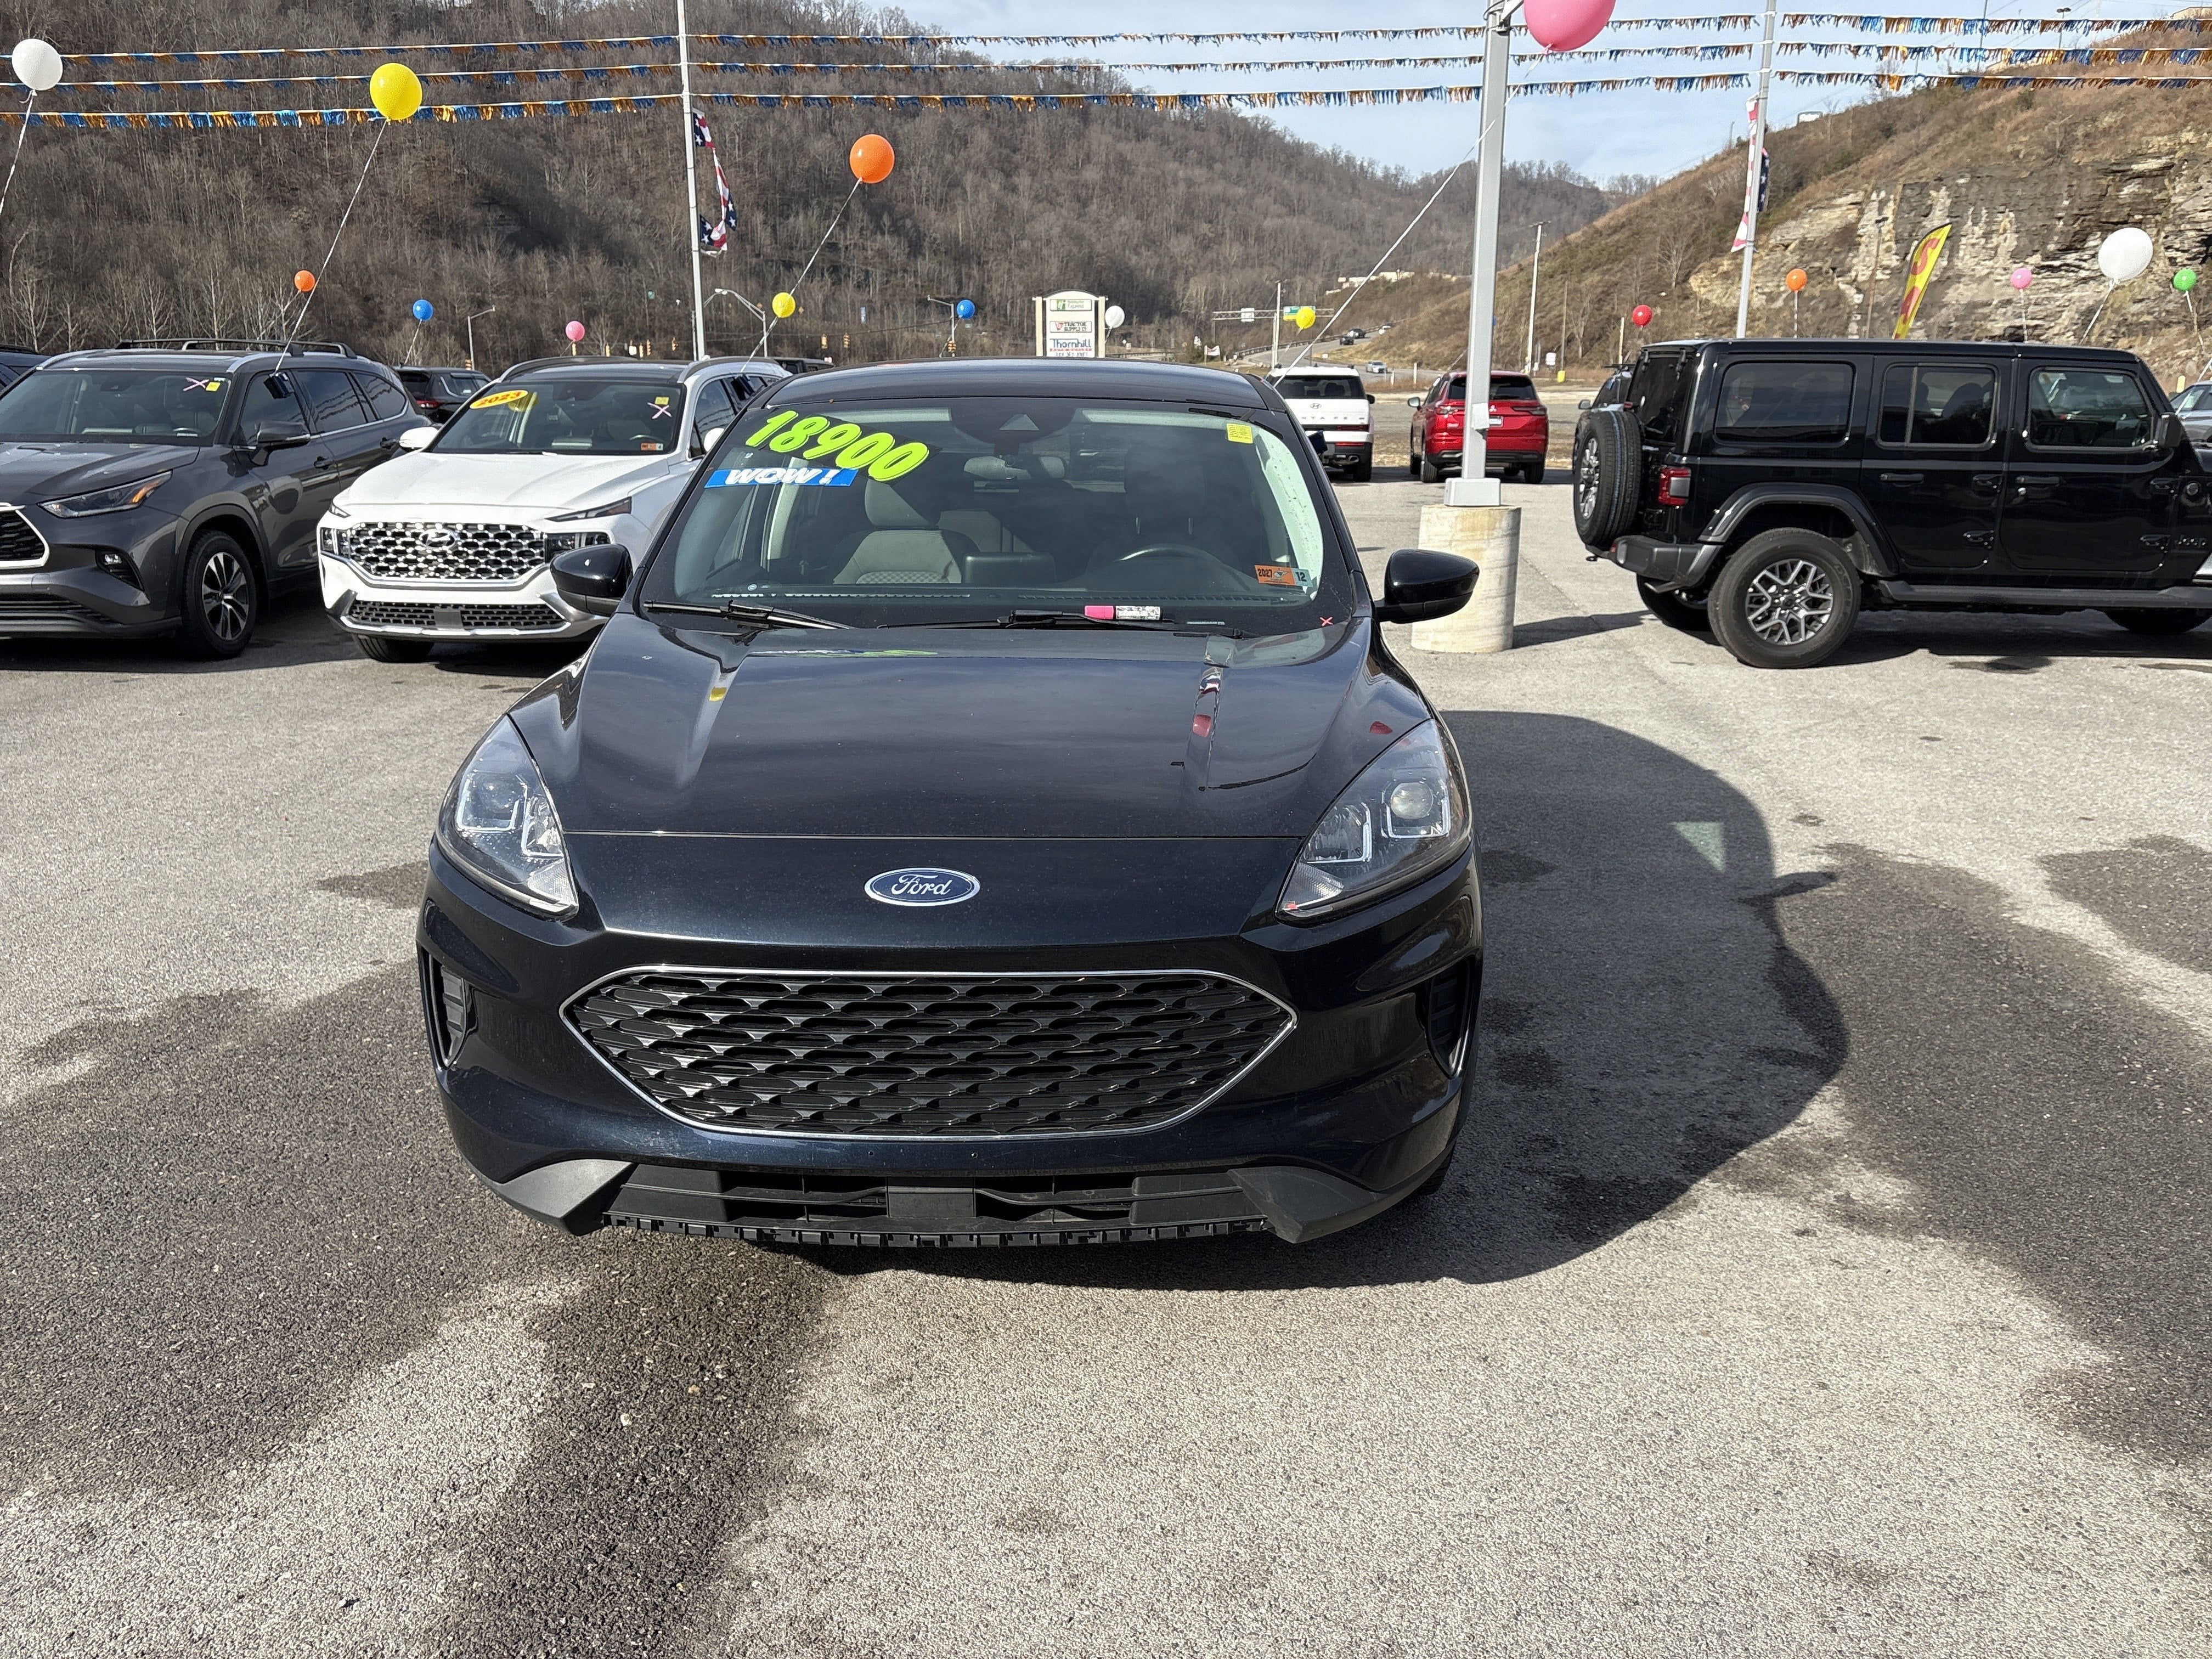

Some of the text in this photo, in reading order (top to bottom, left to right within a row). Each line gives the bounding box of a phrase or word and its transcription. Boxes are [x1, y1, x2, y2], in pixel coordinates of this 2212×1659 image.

[1049, 338, 1092, 348] Thornhill
[477, 392, 521, 407] 2023
[746, 410, 929, 482] 18900
[1257, 568, 1307, 582] 2027 12
[891, 873, 953, 895] Ford
